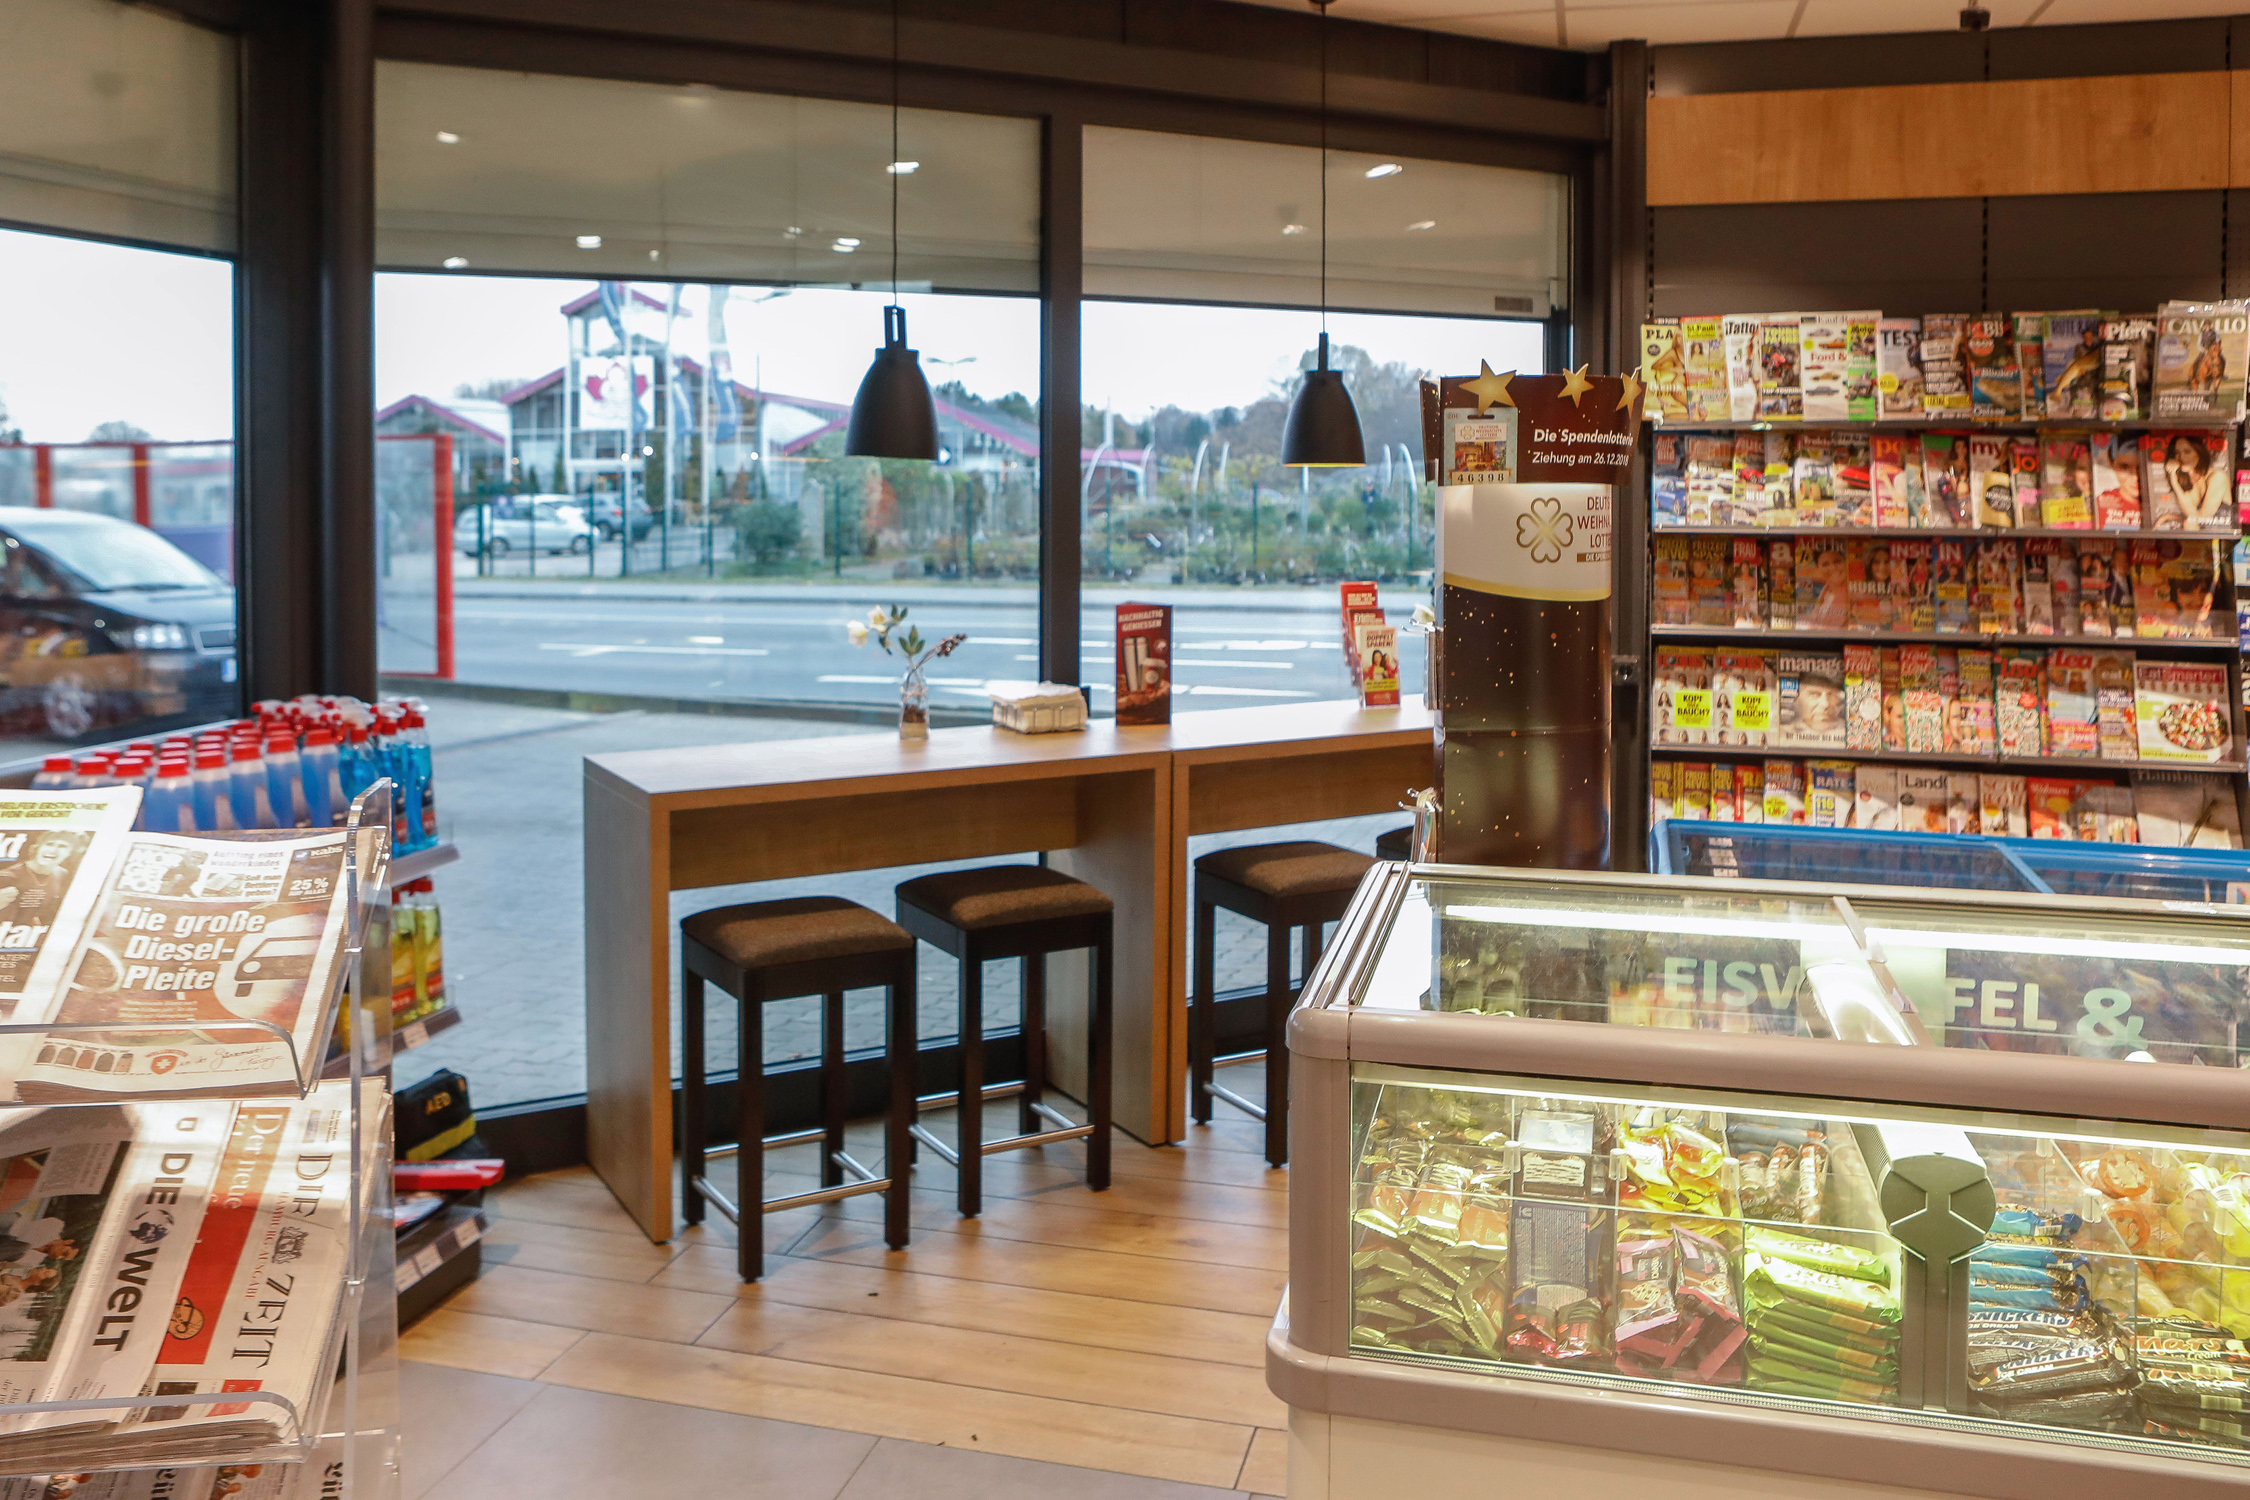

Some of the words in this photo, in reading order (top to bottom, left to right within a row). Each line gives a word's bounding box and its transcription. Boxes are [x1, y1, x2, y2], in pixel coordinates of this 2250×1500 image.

[2167, 318, 2247, 334] CAVLLO
[1533, 428, 1557, 443] Die
[1560, 428, 1635, 447] Spendenlotterie
[1532, 451, 1576, 467] Ziehung
[1577, 454, 1593, 464] am
[1121, 619, 1162, 632] GENIESSEN
[115, 905, 168, 932] Die
[173, 910, 267, 939] große
[124, 934, 236, 962] Diesel-
[121, 964, 217, 991] Pleite
[146, 1153, 194, 1205] DIE
[292, 1153, 334, 1217] DIE
[2017, 1363, 2055, 1377] CREAM
